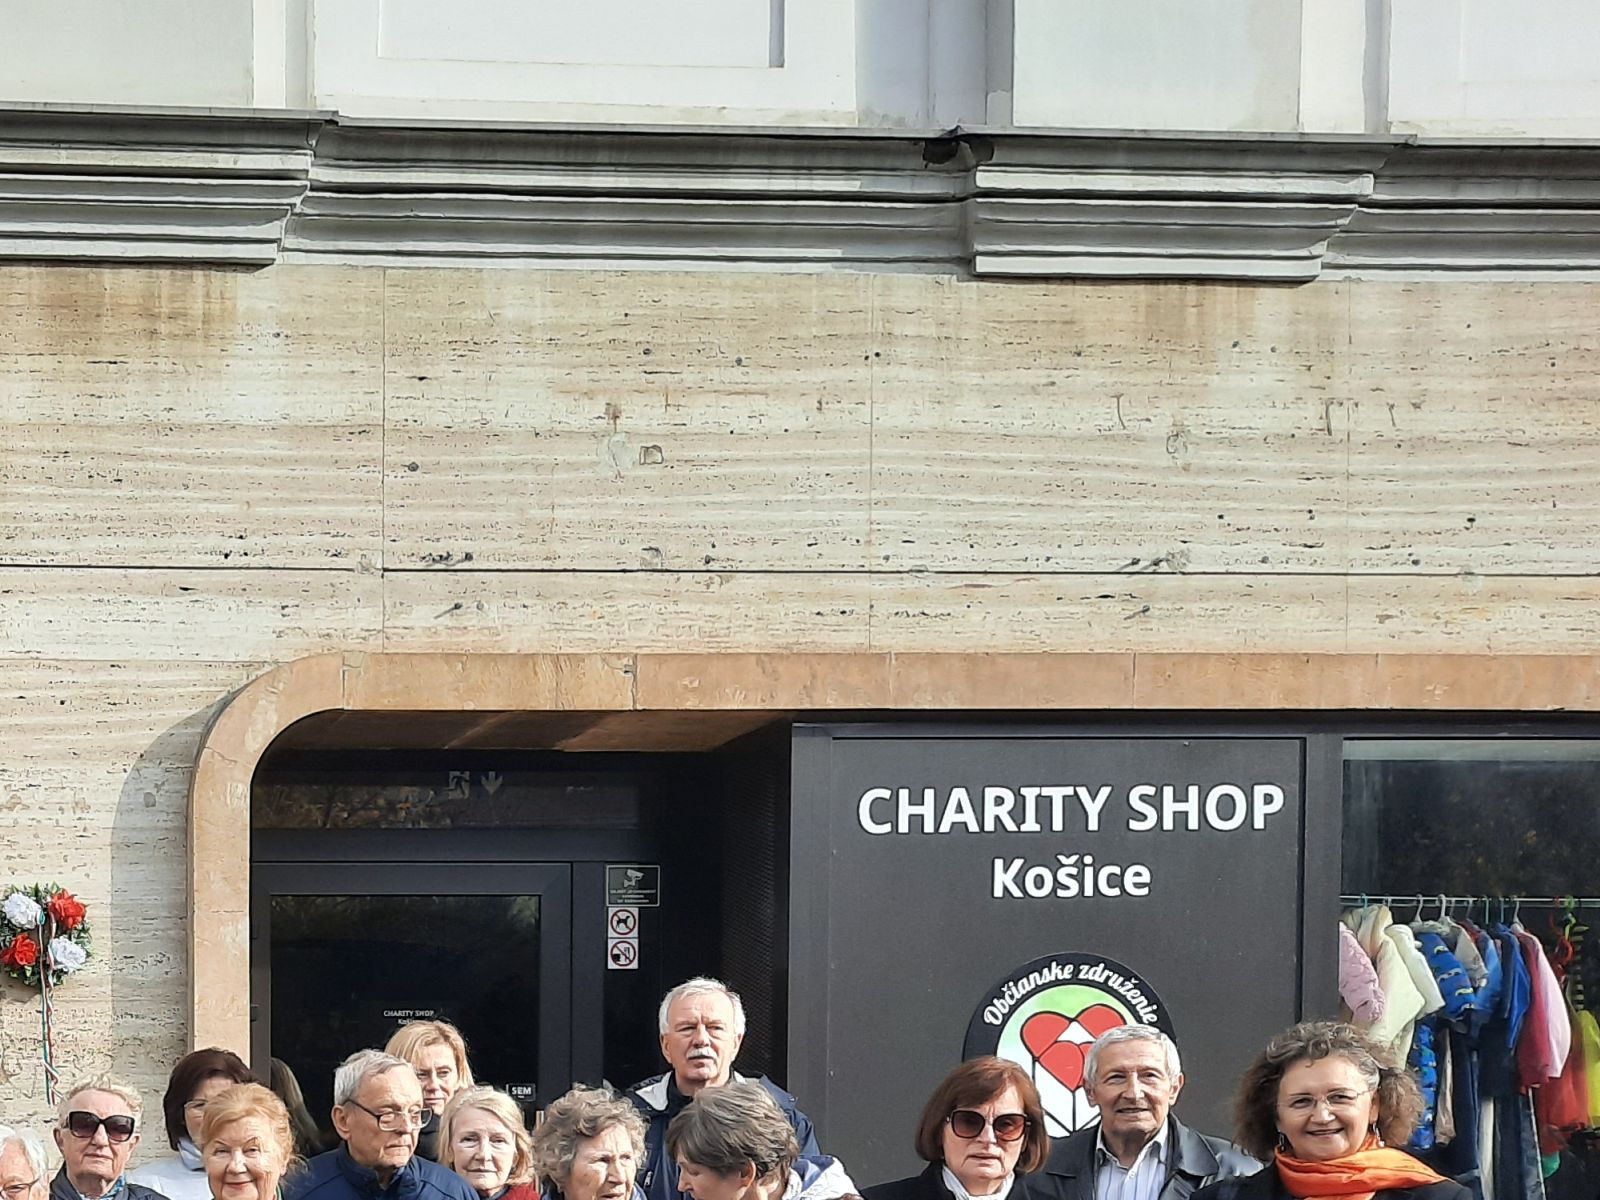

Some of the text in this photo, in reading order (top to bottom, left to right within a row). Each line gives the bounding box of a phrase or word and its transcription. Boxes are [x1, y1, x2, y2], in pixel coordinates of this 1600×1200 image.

[859, 785, 1283, 833] CHARITY SHOP
[994, 855, 1150, 897] Košice
[983, 961, 1158, 1025] Občianske združenie
[511, 1086, 532, 1095] SEM
